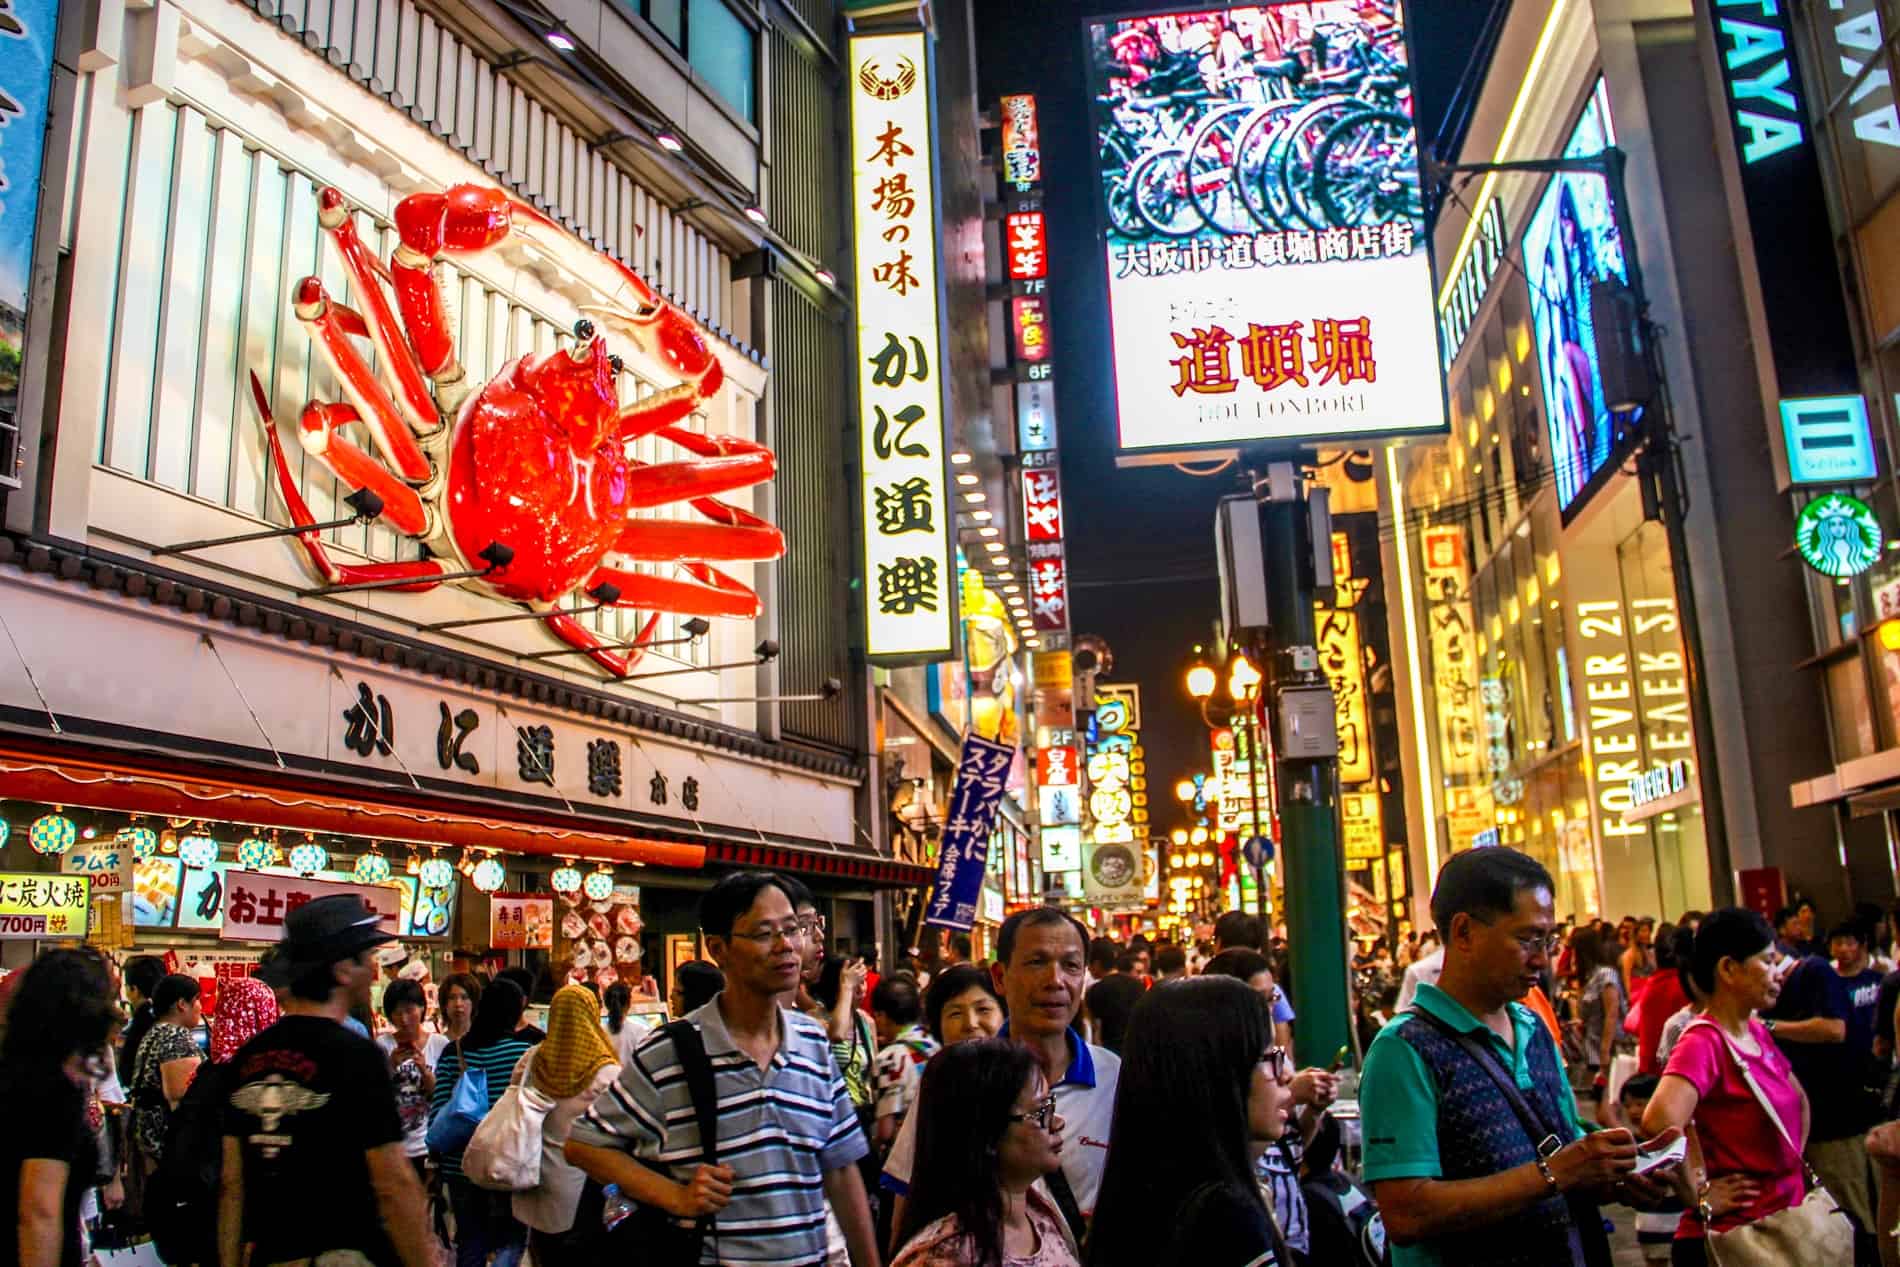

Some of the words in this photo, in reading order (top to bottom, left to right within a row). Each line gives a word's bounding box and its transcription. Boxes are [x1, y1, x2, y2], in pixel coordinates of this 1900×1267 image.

[867, 120, 921, 297] 本場の味
[1024, 281, 1046, 295] 7F
[1169, 314, 1378, 398] 道頓堀
[1051, 730, 1073, 746] 2F
[950, 747, 986, 840] ステーキ
[964, 752, 1009, 862] タラバかに
[72, 853, 121, 872] ラムネ
